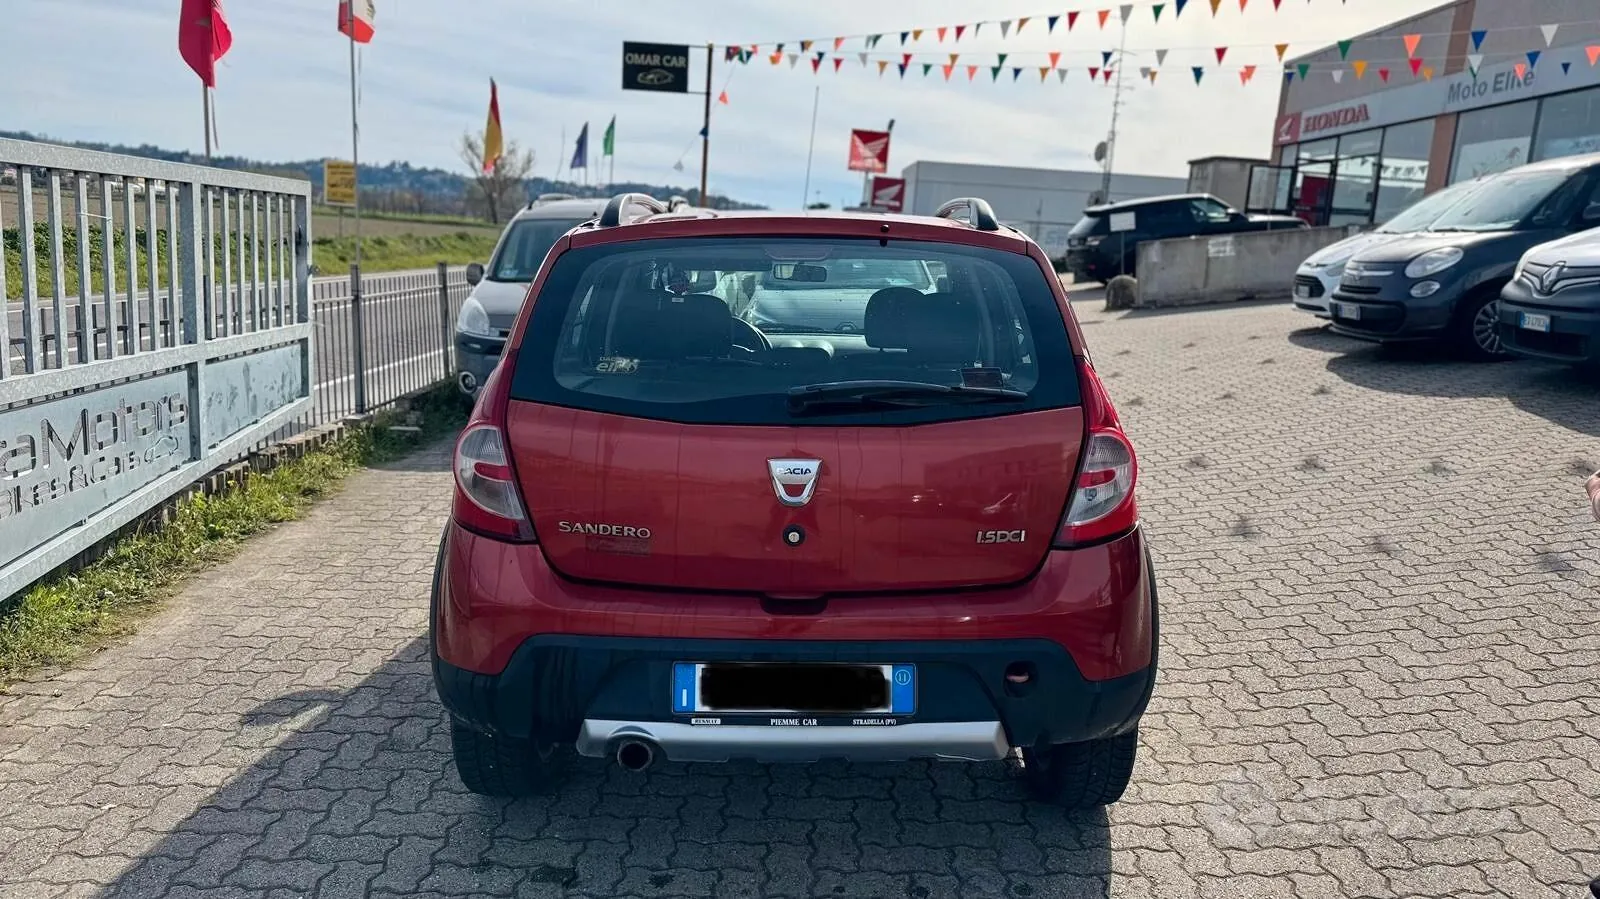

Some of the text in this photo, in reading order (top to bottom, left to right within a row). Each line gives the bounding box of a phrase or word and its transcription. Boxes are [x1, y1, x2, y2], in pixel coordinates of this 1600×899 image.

[625, 53, 687, 68] OMAR CAR
[1448, 80, 1489, 104] Moto
[1302, 103, 1371, 133] HONDA
[0, 393, 189, 480] aMotors
[558, 520, 651, 538] SANDERO
[770, 718, 818, 726] PIEMME CAR
[852, 718, 885, 726] STRADELLA
